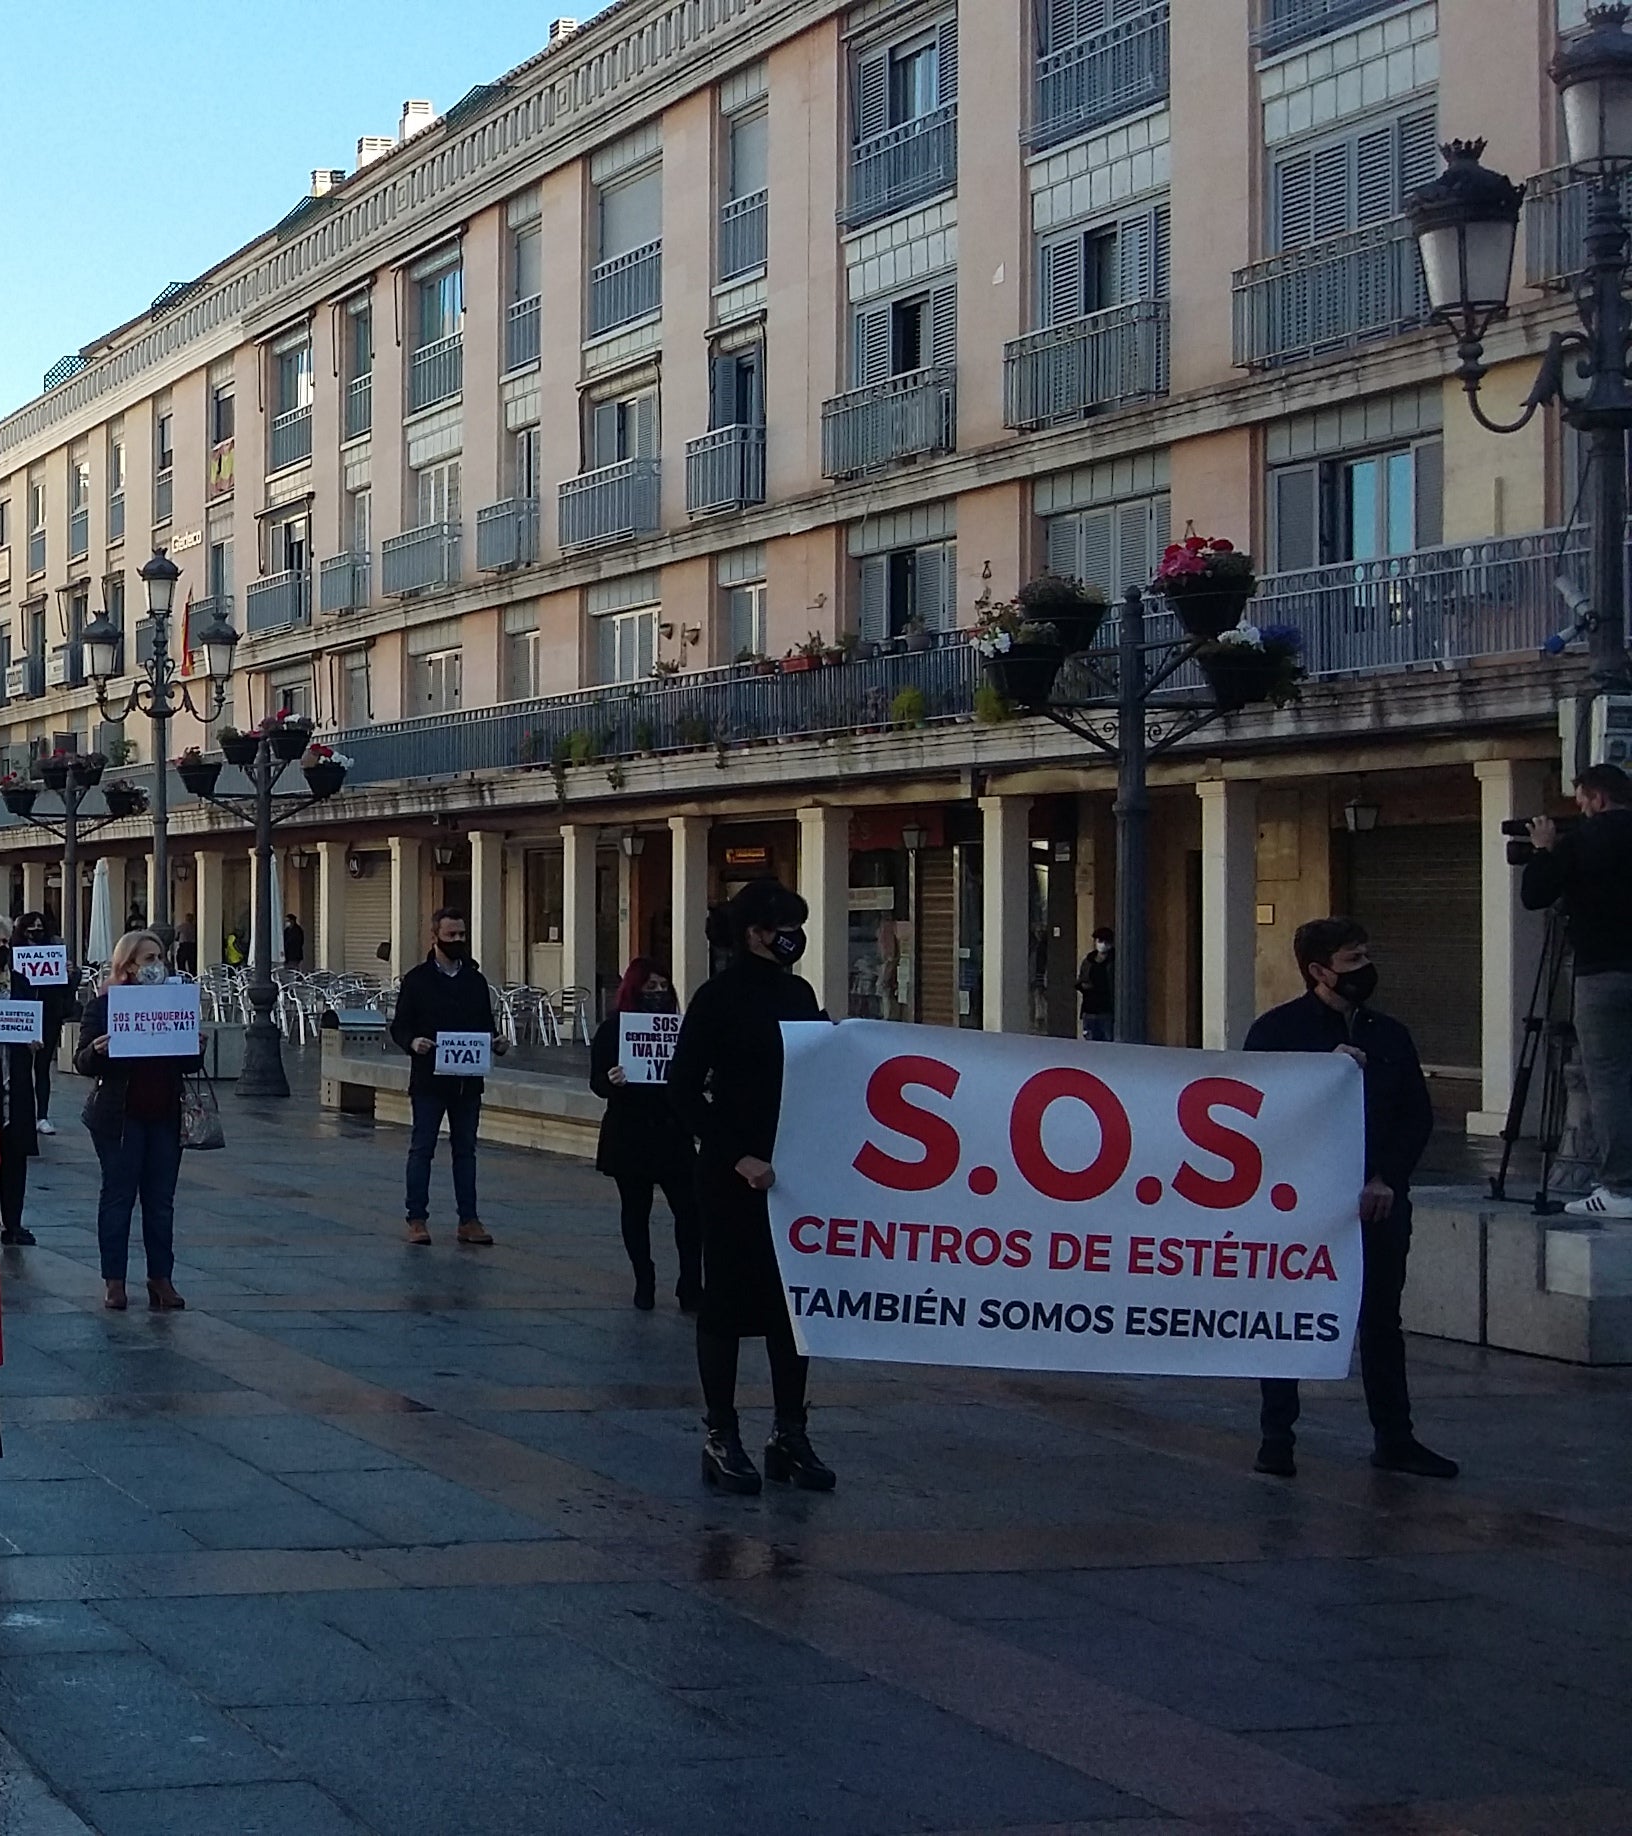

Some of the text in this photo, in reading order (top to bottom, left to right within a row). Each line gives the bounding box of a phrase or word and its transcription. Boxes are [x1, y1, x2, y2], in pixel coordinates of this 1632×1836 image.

[171, 531, 202, 554] Gedeco
[46, 951, 63, 959] 10%
[21, 961, 60, 977] ¡YA!
[113, 1008, 195, 1022] SOS PELUQUERÍAS
[114, 1023, 130, 1032] IVA
[134, 1023, 146, 1031] AL
[173, 1021, 195, 1031] YA!!
[653, 1016, 679, 1032] SOS
[625, 1031, 662, 1043] CENTROS
[444, 1050, 480, 1064] ¡YA!
[632, 1043, 670, 1058] IVA AL
[852, 1055, 1298, 1212] S.O.S.
[788, 1215, 1338, 1282] CENTROS DE ESTÉTICA
[788, 1286, 1341, 1342] TAMBIÉN SOMOS ESENCIALES
